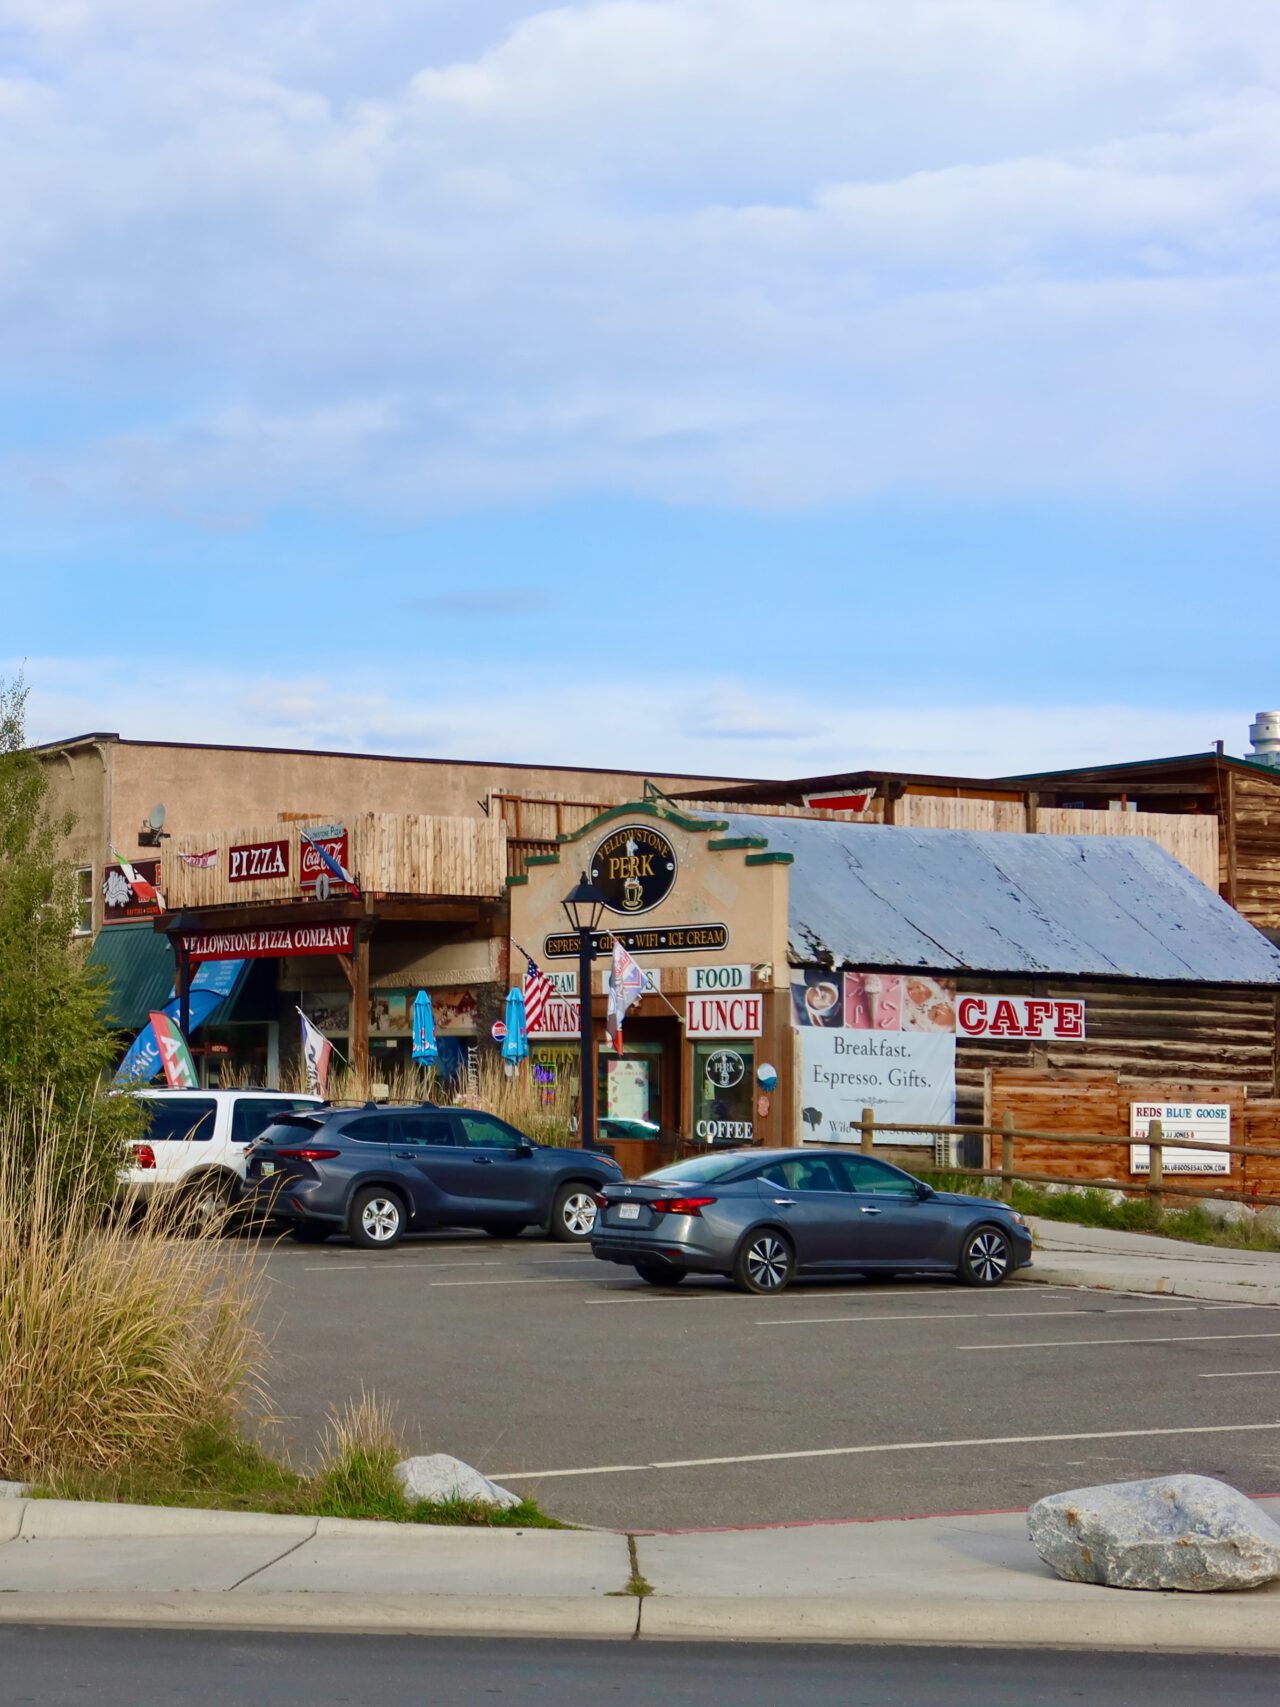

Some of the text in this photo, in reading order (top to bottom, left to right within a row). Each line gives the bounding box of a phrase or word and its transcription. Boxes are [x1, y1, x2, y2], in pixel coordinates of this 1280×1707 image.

[597, 829, 670, 860] YELLOWSTONE
[230, 844, 286, 878] PIZZA
[609, 854, 655, 880] PERK
[183, 926, 351, 954] YELLOWSTONE PIZZA COMPANY
[636, 933, 660, 947] WIFI
[669, 932, 685, 946] ICE
[687, 929, 724, 945] CREAM
[696, 968, 743, 988] FOOD
[688, 999, 760, 1032] LUNCH
[958, 997, 1083, 1038] CAFE
[834, 1036, 912, 1058] Breakfast.
[714, 1062, 736, 1073] PERK
[813, 1064, 932, 1089] Espresso. Gifts.
[1136, 1107, 1227, 1119] REDS BLUE GOOSE
[696, 1120, 753, 1139] COFFEE
